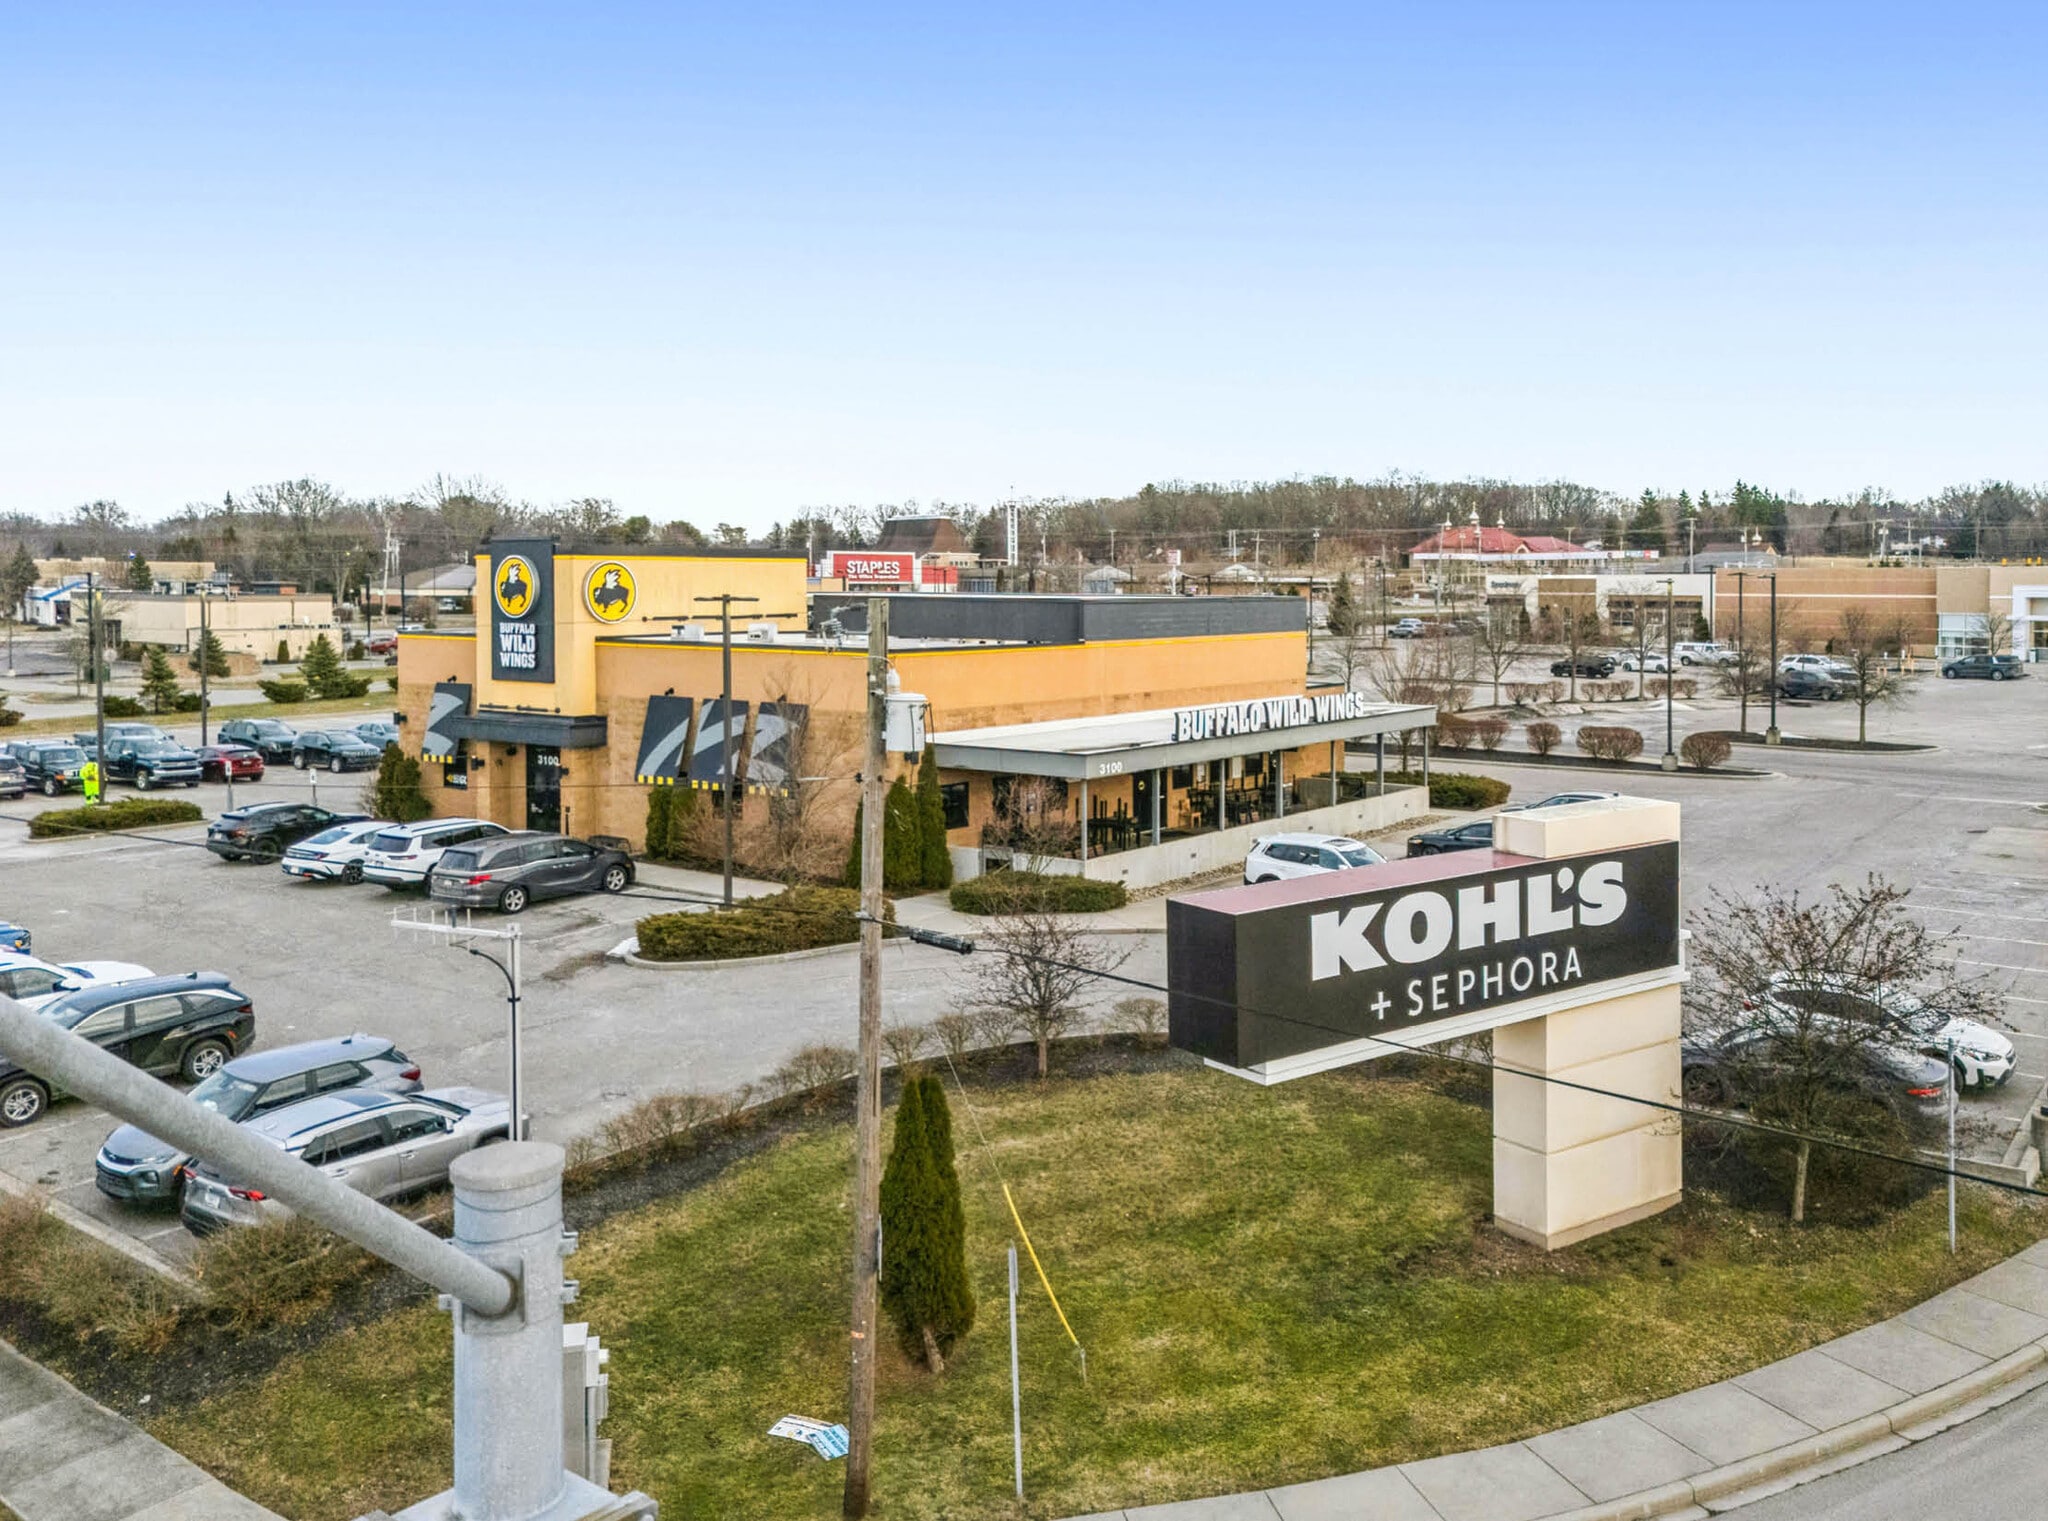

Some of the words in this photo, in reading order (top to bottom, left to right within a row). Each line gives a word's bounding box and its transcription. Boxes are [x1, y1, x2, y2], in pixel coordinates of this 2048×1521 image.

[847, 560, 900, 574] STAPLES
[499, 622, 536, 635] BUFFALO
[499, 634, 536, 653] WILD
[500, 653, 536, 668] WINGS
[1178, 703, 1261, 741] BUFFALO
[1267, 697, 1310, 728] WILD
[1315, 691, 1364, 723] WINGS
[1099, 761, 1123, 775] 3100
[1310, 861, 1628, 982] KOHL'S
[1408, 946, 1583, 1017] SEPHORA
